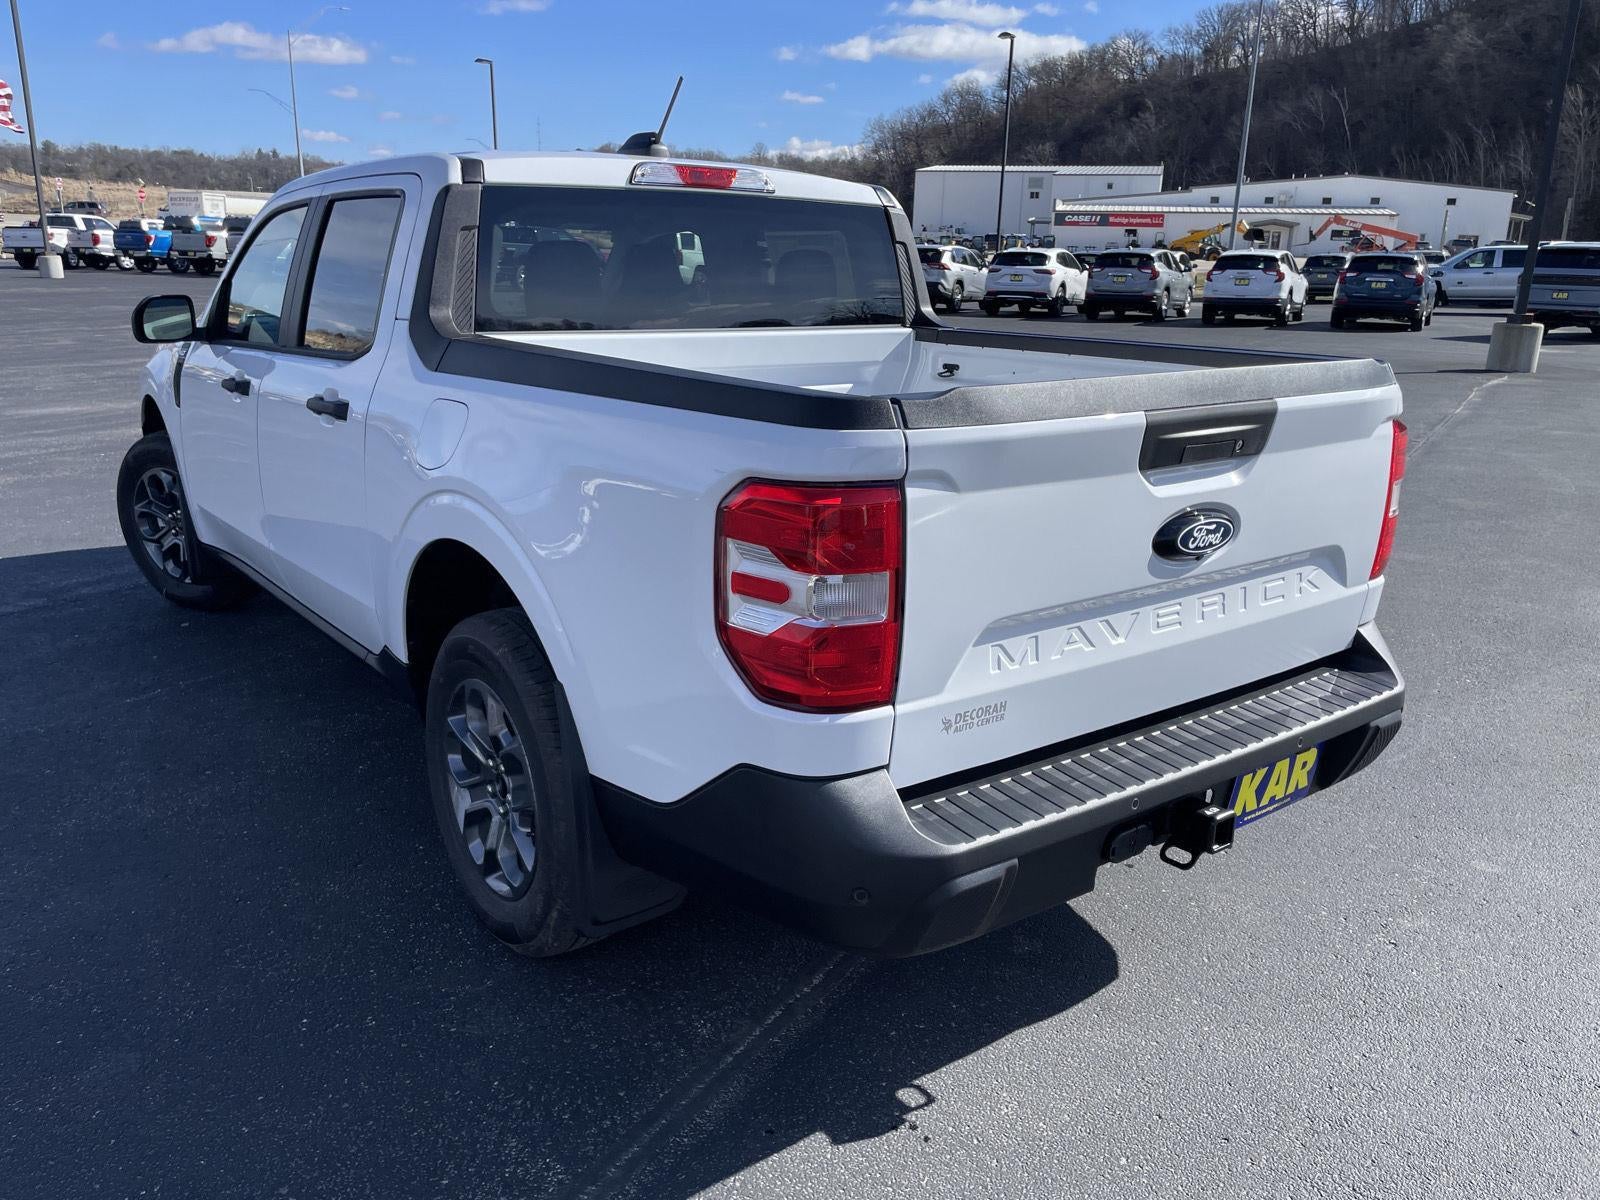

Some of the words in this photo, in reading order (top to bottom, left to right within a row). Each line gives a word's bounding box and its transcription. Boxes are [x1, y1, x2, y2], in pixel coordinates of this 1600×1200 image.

[1065, 214, 1091, 222] CASE
[1188, 523, 1225, 549] Ford
[988, 567, 1322, 675] MAVERICK
[952, 721, 974, 734] AUTO
[976, 712, 1006, 728] CENTER
[953, 700, 1008, 725] DECORAH
[1233, 747, 1318, 817] KAR
